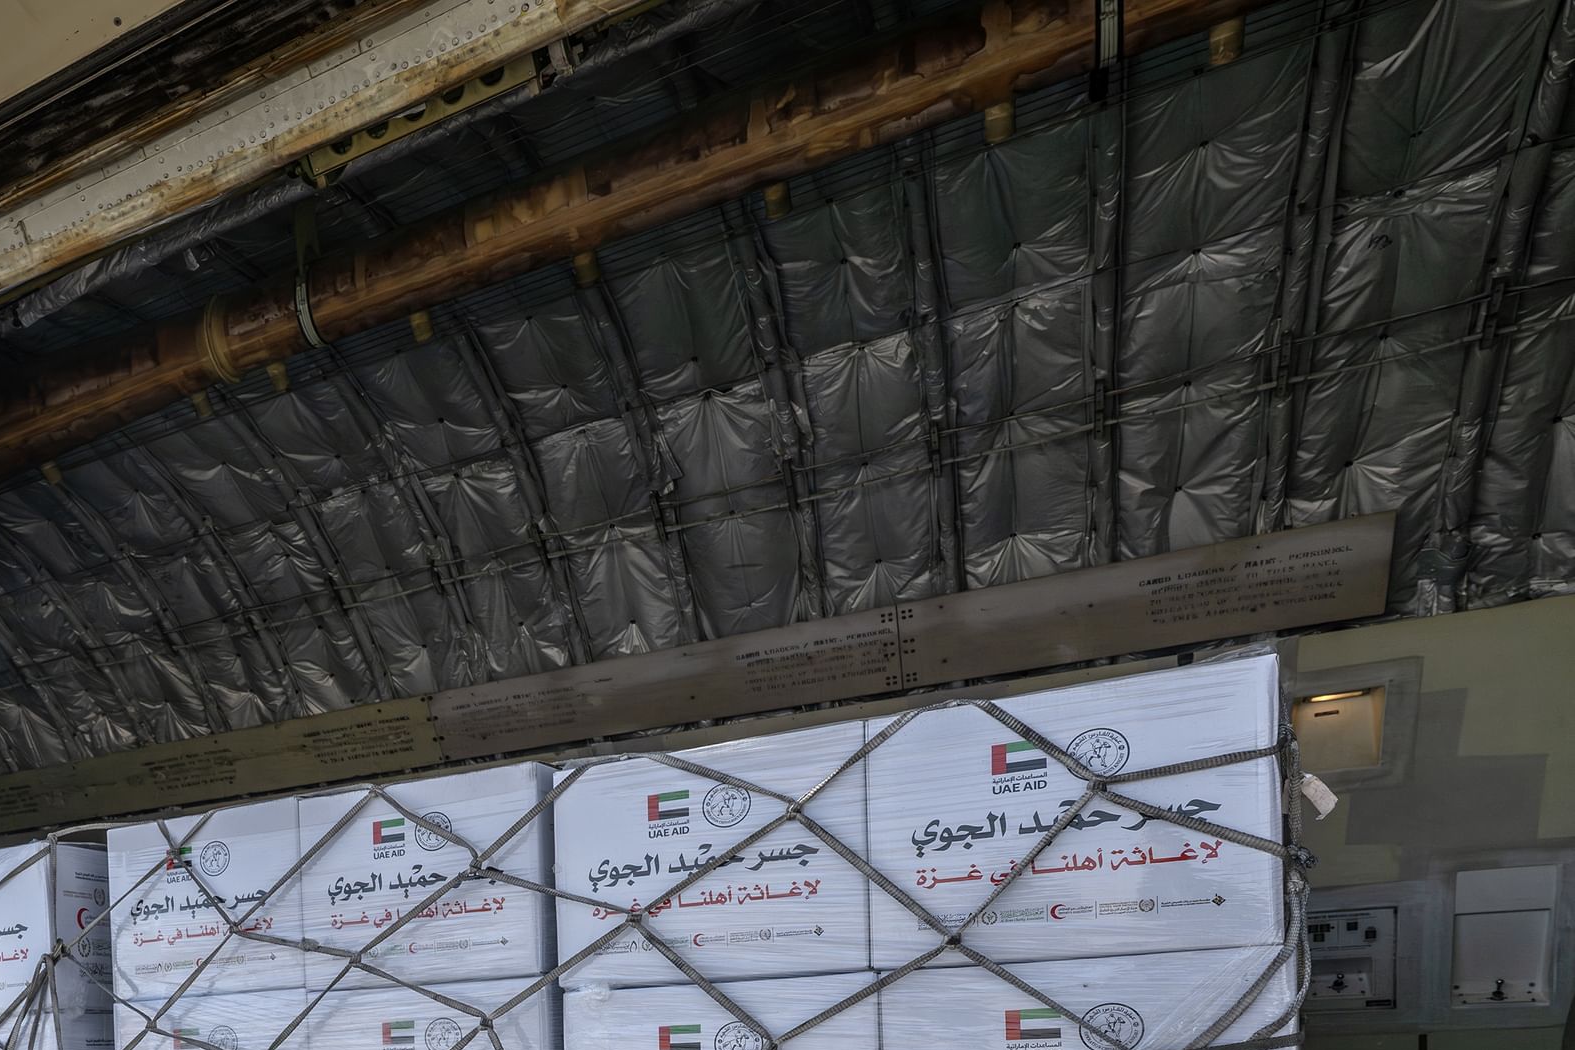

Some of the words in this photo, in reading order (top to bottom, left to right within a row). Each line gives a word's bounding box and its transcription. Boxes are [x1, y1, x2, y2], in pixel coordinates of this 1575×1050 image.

[1139, 576, 1171, 587] CARGO
[1178, 567, 1225, 580] LOADERS
[1289, 544, 1353, 560] PERSONNEL
[993, 782, 1020, 794] UAE
[1024, 780, 1047, 791] AID
[649, 829, 669, 838] UAE
[672, 827, 689, 836] AID
[911, 811, 1006, 857] الجوي
[374, 851, 390, 860] UAE
[391, 850, 405, 858] AID
[745, 843, 819, 871] جسر
[1032, 848, 1103, 875] أهلنا
[1111, 840, 1222, 871] لإغاثة
[167, 875, 180, 884] UAE
[389, 864, 447, 898] حميد
[589, 853, 659, 892] الجوي
[916, 864, 983, 889] غزة
[328, 872, 383, 905] الجوي
[679, 886, 732, 908] أهلنا
[737, 880, 821, 904] لإغاثة
[131, 896, 174, 925] الجوي
[373, 910, 392, 928] في
[442, 897, 505, 918] لإغاثة
[186, 922, 219, 938] أهلنا
[331, 911, 369, 930] غزة
[134, 931, 164, 946] غزة
[167, 928, 183, 945] في
